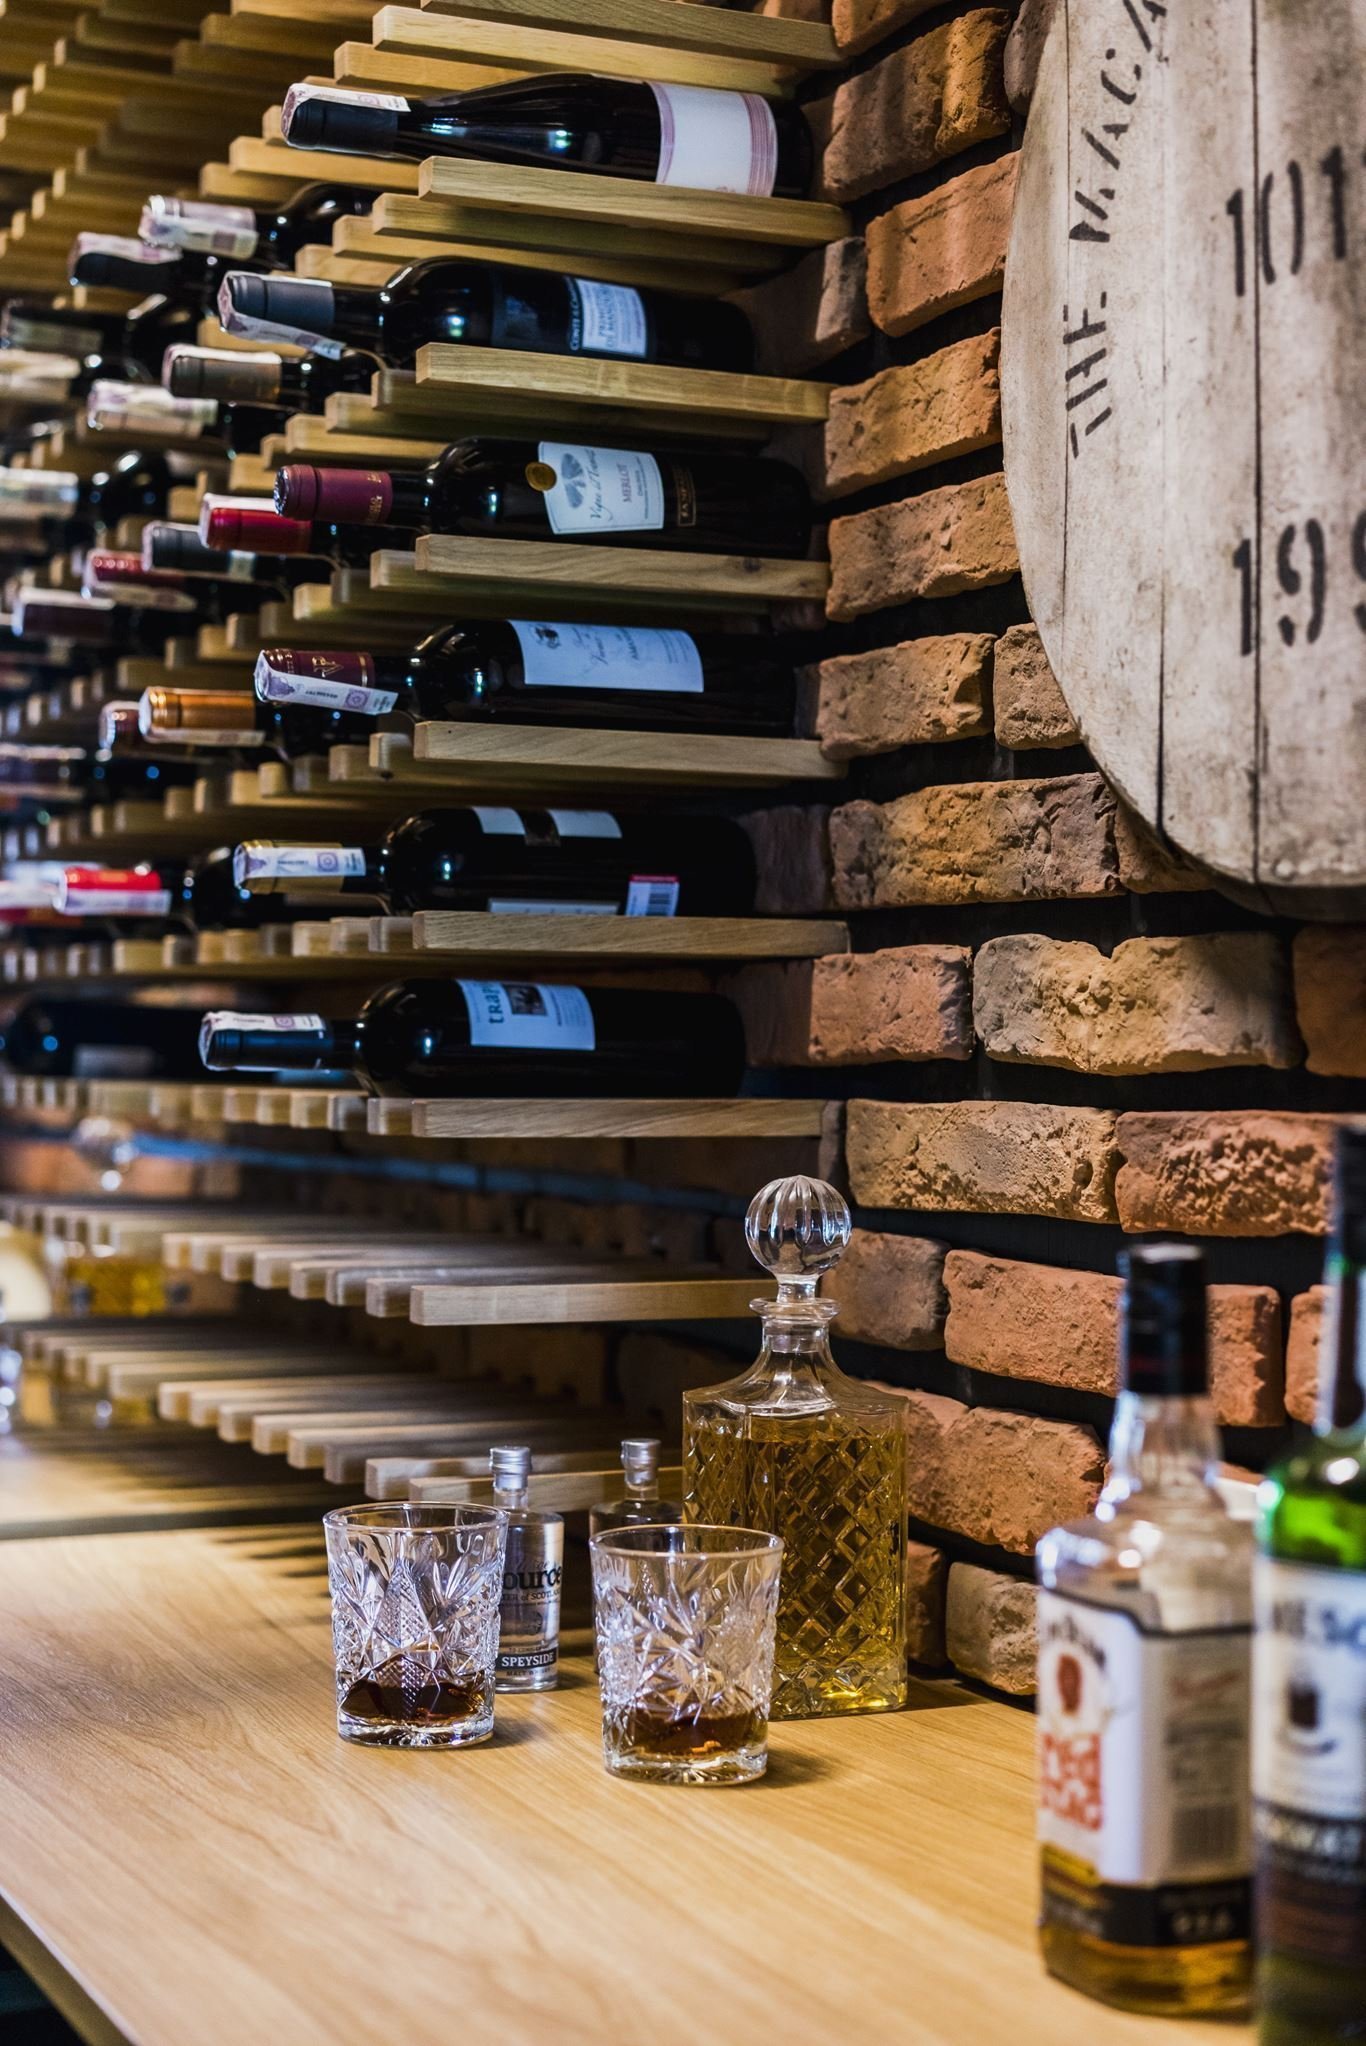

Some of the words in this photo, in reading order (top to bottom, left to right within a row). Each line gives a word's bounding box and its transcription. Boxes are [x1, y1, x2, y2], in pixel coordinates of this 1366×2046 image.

[1225, 144, 1366, 298] 101
[1062, 291, 1113, 459] THE
[616, 463, 632, 503] MERLOT
[503, 1565, 562, 1590] ource
[501, 1651, 555, 1667] SPEYSIDE
